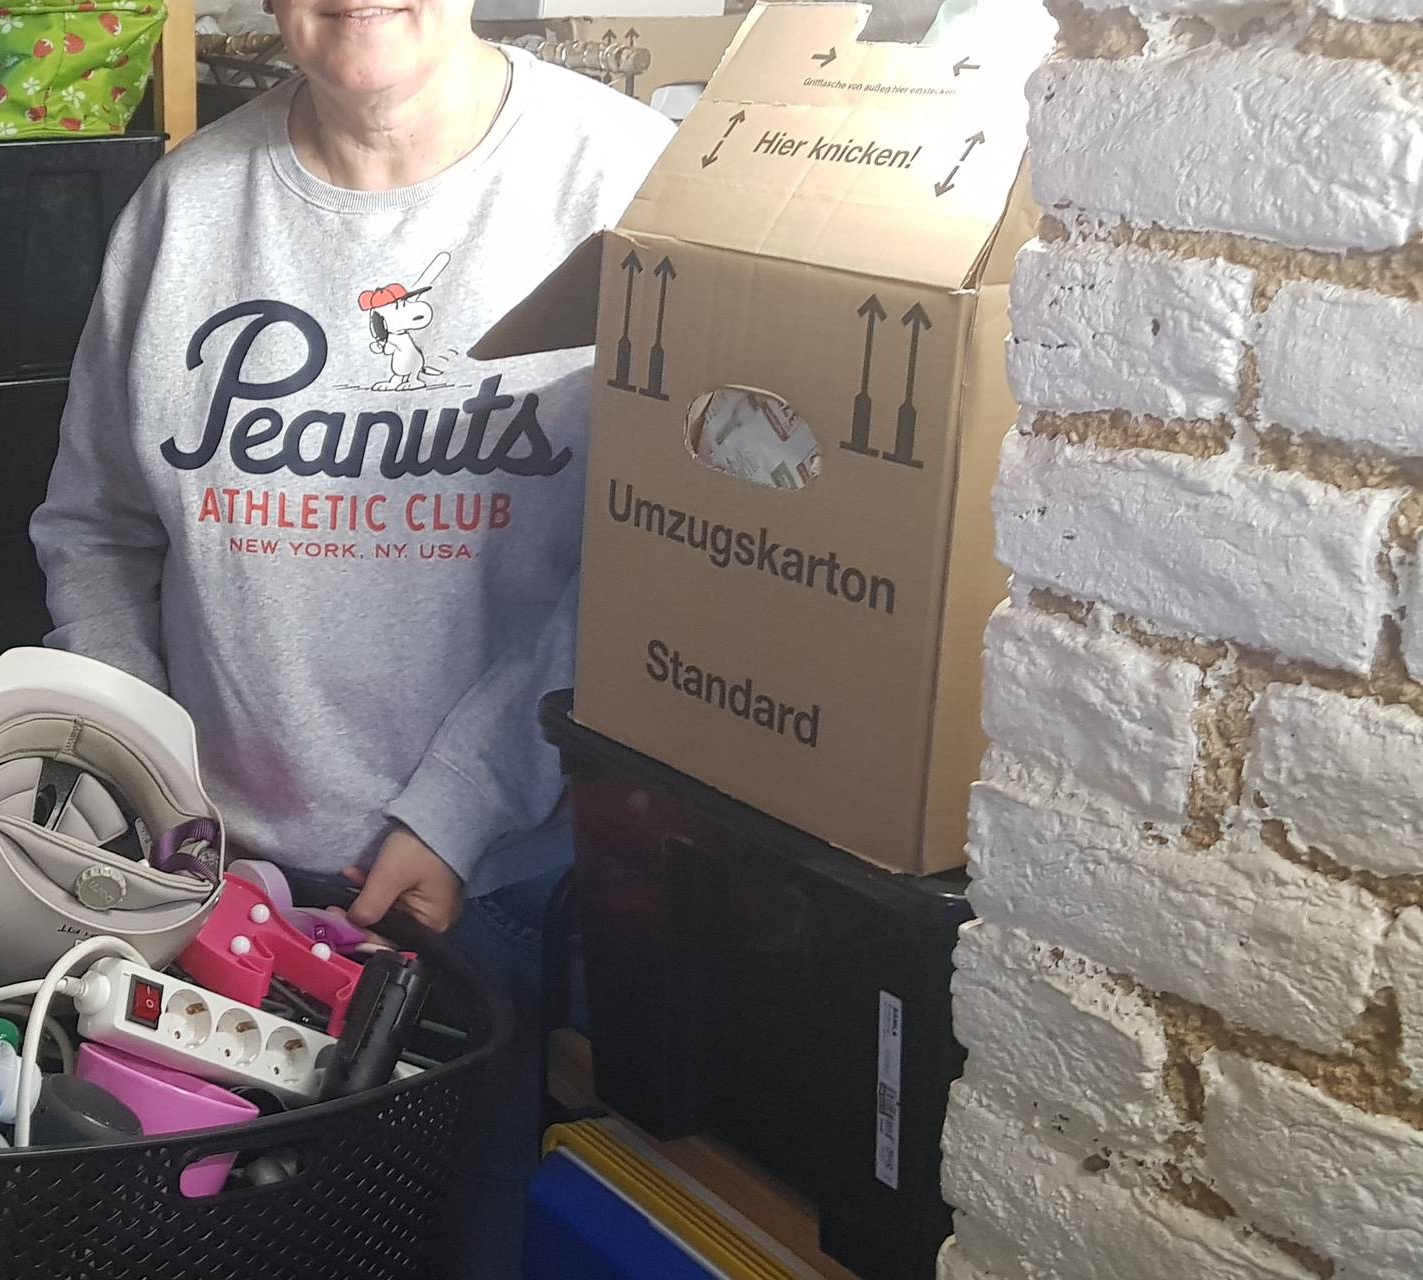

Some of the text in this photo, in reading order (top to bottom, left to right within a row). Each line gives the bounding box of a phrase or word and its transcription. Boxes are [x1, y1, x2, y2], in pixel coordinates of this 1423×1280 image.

[847, 82, 863, 91] von
[892, 85, 908, 95] hier
[753, 130, 923, 169] Hier knicken!
[160, 299, 574, 480] Peanuts
[198, 487, 513, 532] ATHLETIC CLUB
[229, 537, 278, 555] NEW
[609, 478, 896, 615] Umzugskarton
[646, 639, 820, 748] Standard
